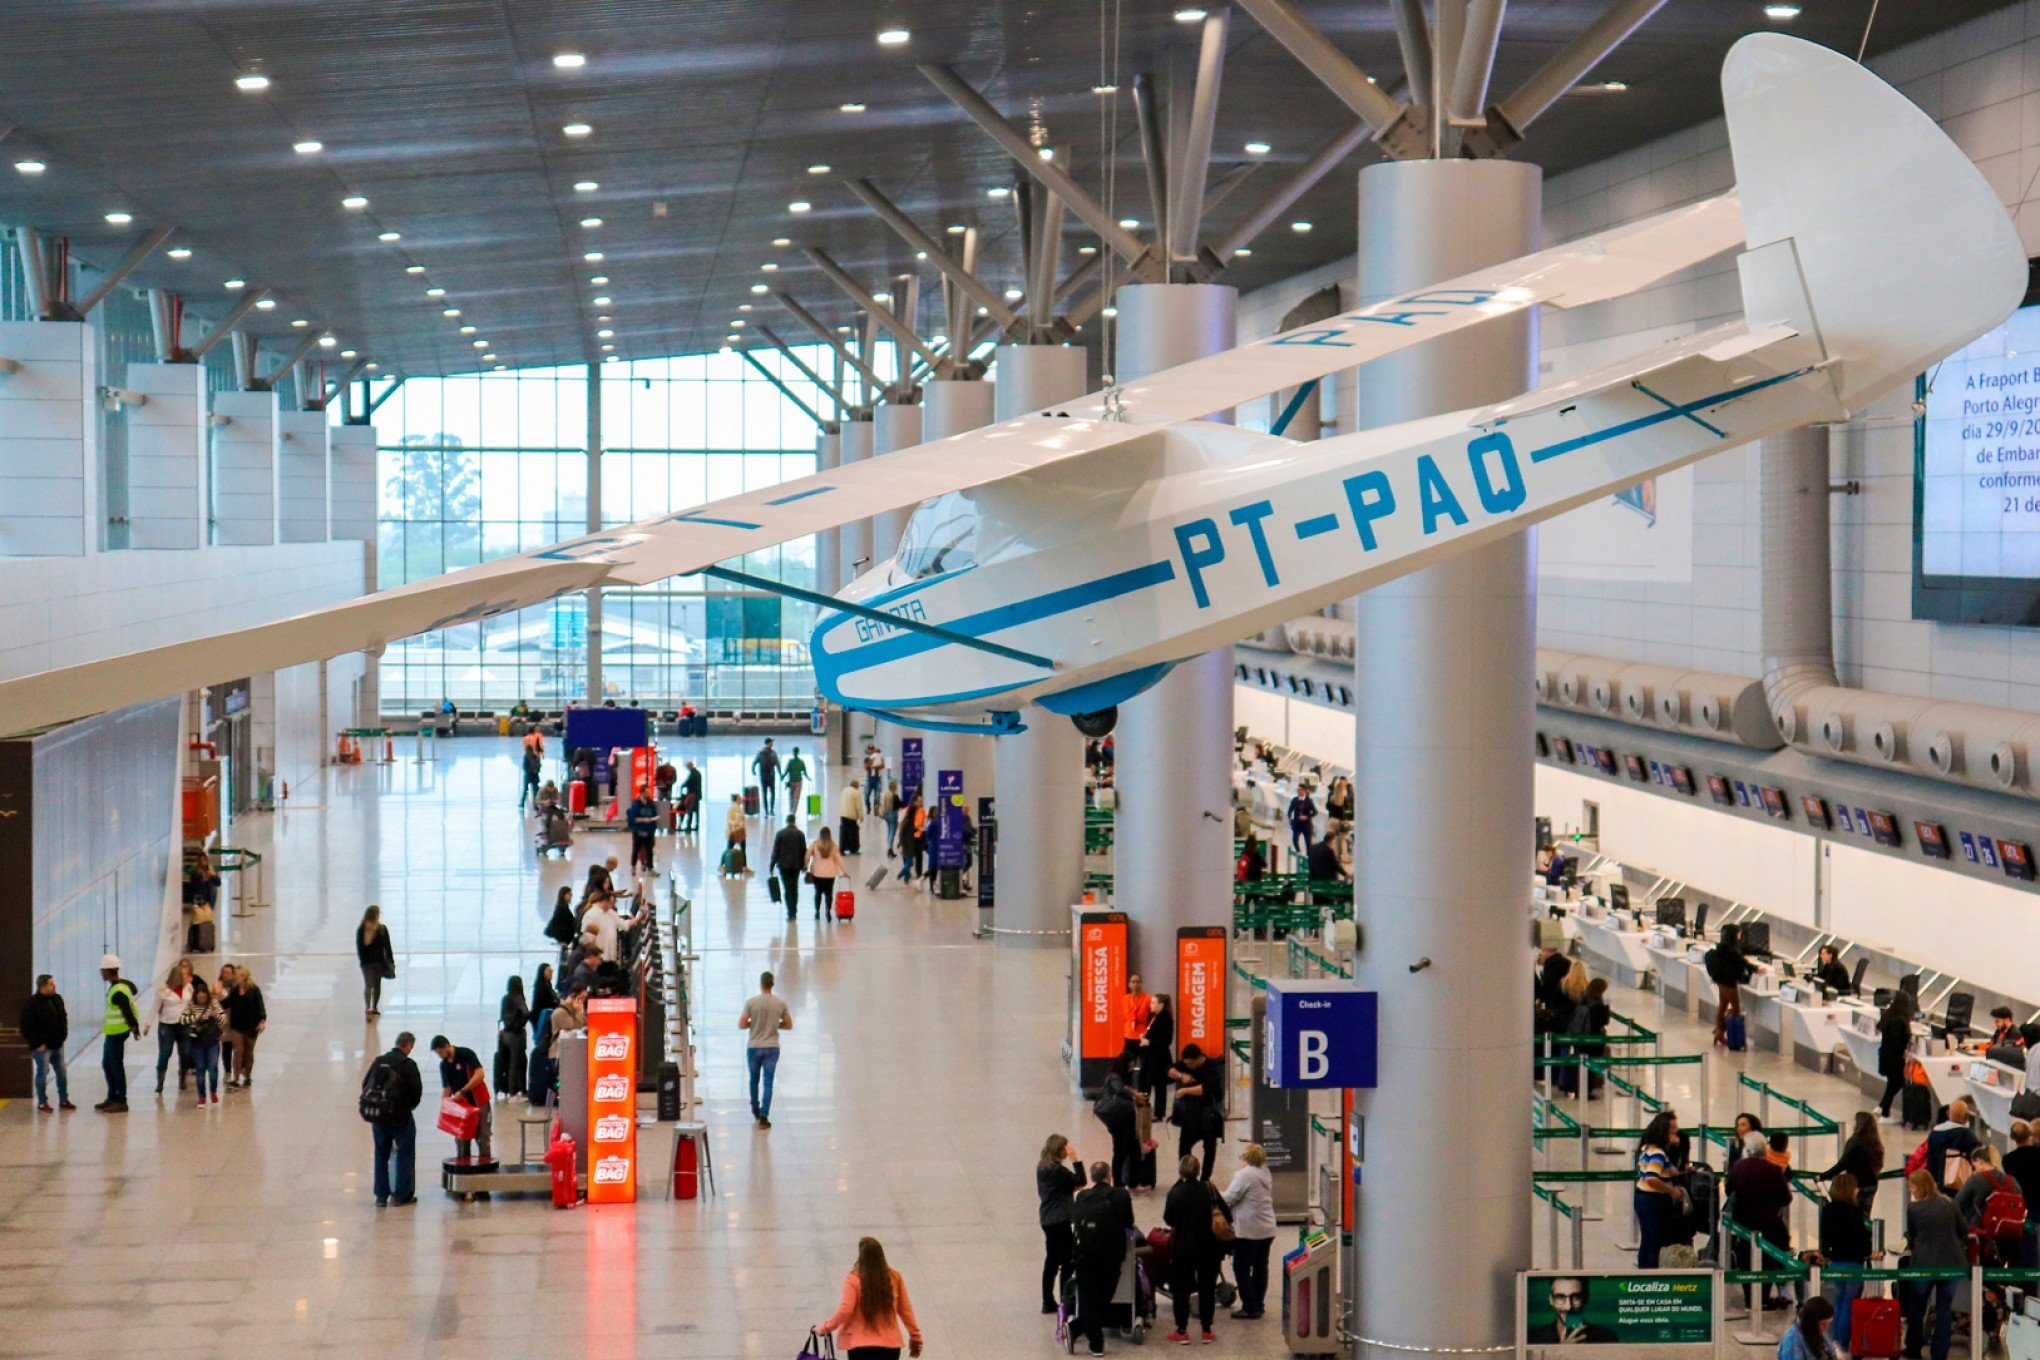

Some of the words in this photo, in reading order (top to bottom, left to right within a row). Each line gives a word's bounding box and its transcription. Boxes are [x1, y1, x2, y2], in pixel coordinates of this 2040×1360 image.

[1966, 375, 1975, 390] A
[1979, 369, 2029, 391] Fraport
[1964, 399, 2000, 415] Porto
[1962, 424, 1982, 440] dia
[1976, 447, 1993, 463] de
[2004, 496, 2019, 513] 21
[1173, 431, 1527, 609] PT-PAQ
[1094, 946, 1108, 1023] EXPRESSA
[1191, 961, 1206, 1039] BAGAGEM
[1299, 1000, 1332, 1009] Check-in
[597, 1045, 625, 1058] BAG
[1299, 1029, 1330, 1080] B
[597, 1086, 625, 1099] BAG
[597, 1127, 625, 1140] BAG
[597, 1168, 625, 1181] BAG
[1628, 1281, 1670, 1292] Localiza
[1672, 1283, 1698, 1292] Hertz
